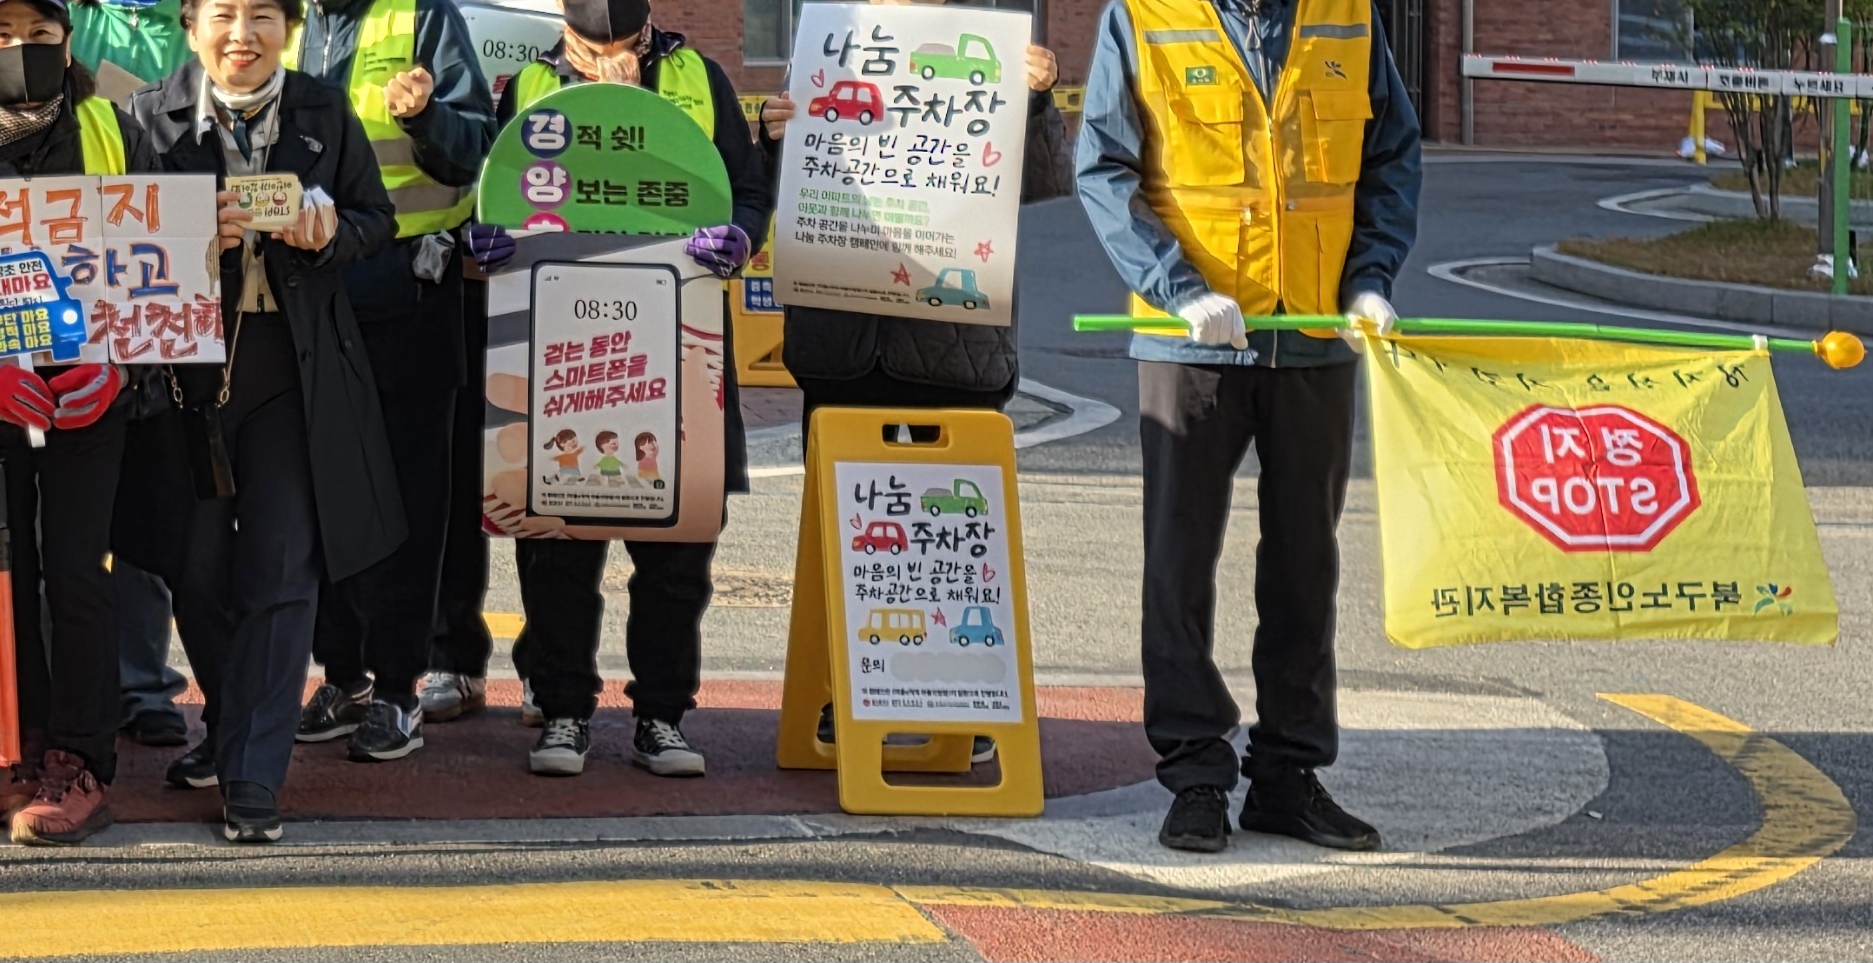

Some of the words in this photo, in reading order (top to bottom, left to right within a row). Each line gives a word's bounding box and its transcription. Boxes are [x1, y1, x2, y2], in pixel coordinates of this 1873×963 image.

[483, 39, 539, 64] 08:30
[823, 25, 899, 76] 나눔
[887, 85, 1006, 137] 주차장
[528, 114, 602, 151] 경적
[611, 125, 645, 152] 쉿!
[804, 132, 868, 156] 마음의
[878, 135, 898, 159] 빈
[907, 135, 971, 168] 공간을
[526, 166, 628, 207] 양보는
[636, 179, 689, 208] 존중
[802, 156, 917, 188] 주차공간으로
[925, 172, 1001, 197] 채워요!
[795, 230, 815, 243] 나눔
[817, 234, 847, 247] 주차장
[796, 216, 816, 228] 주차
[818, 219, 848, 232] 공간을
[915, 229, 955, 244] 이어가는
[19, 260, 43, 273] 안전
[21, 308, 49, 323] 마요
[574, 298, 638, 321] 08:30
[22, 321, 51, 336] 마요
[25, 334, 52, 349] 마요
[543, 341, 585, 366] 걷는
[589, 330, 632, 358] 동안
[543, 354, 648, 391] 스마트폰을
[542, 377, 667, 418] 쉬게해주세요
[854, 475, 912, 516] 나눔
[910, 521, 995, 559] 주차장
[854, 563, 901, 582] 마음의
[907, 562, 922, 582] 빈
[929, 560, 977, 585] 공간을
[855, 583, 941, 604] 주차공간으로
[947, 587, 1001, 604] 채워요!
[861, 657, 885, 674] 문의
